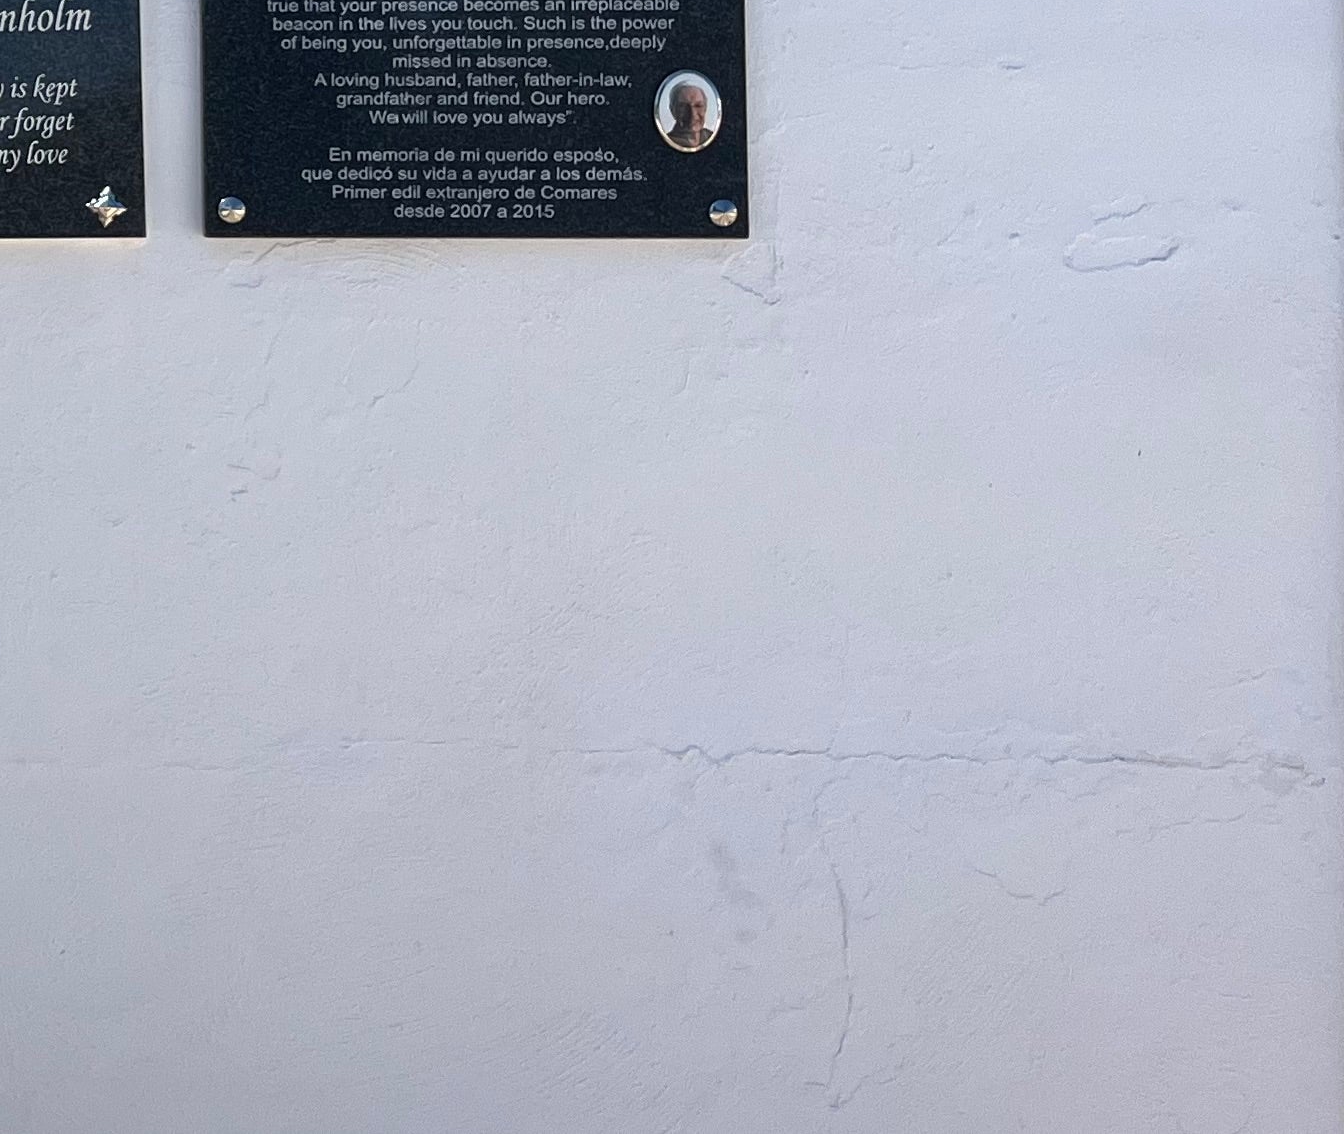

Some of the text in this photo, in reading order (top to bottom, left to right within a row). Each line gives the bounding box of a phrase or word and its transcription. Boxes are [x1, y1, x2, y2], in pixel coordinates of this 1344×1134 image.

[315, 73, 631, 90] A loving husband, father, father-in-law,
[337, 91, 609, 108] grandfather and friend. Our hero.
[7, 107, 76, 139] forget
[27, 143, 68, 164] love
[329, 147, 619, 164] En memoria de mi querido esposo,
[333, 185, 617, 203] Primer edil extranjero de Comares
[394, 204, 554, 218] desde 2007 a 2015
